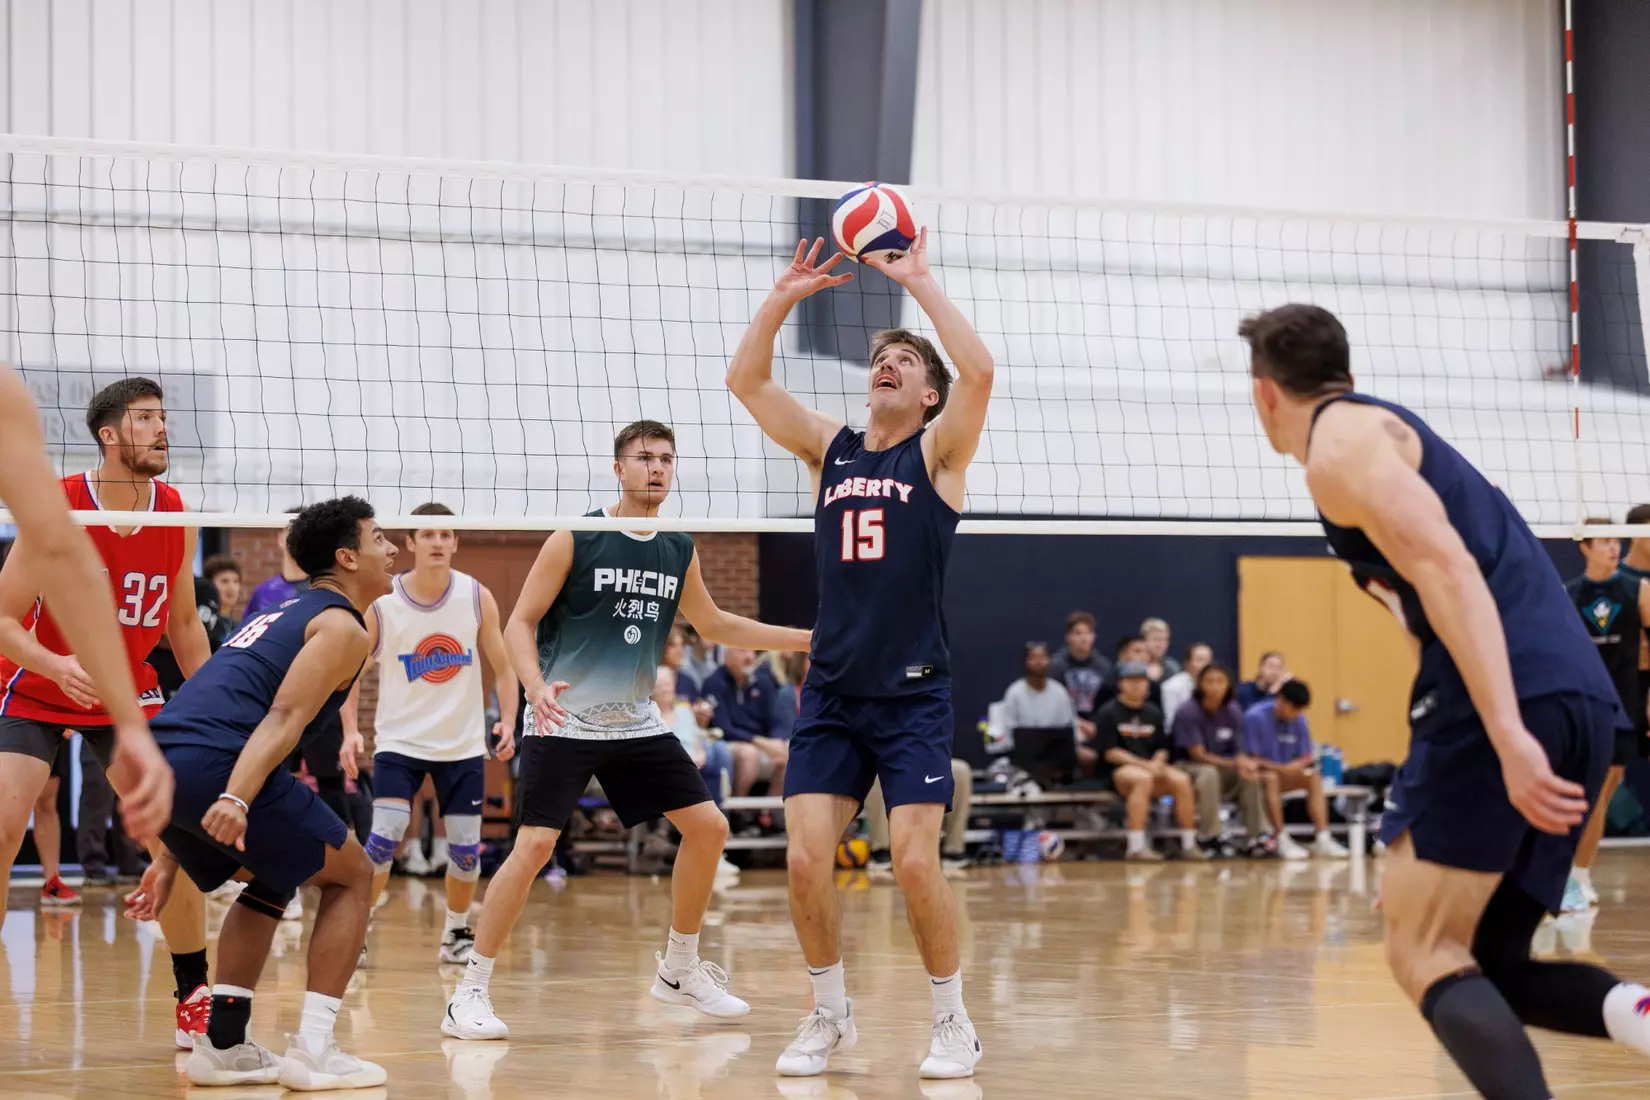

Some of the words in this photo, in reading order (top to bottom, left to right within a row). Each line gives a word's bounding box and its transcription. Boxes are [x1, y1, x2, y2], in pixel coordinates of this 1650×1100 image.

[823, 476, 914, 508] LIBERTY
[841, 507, 885, 562] 15
[117, 571, 168, 627] 32
[612, 597, 660, 622] 火烈鸟
[221, 611, 285, 649] 16
